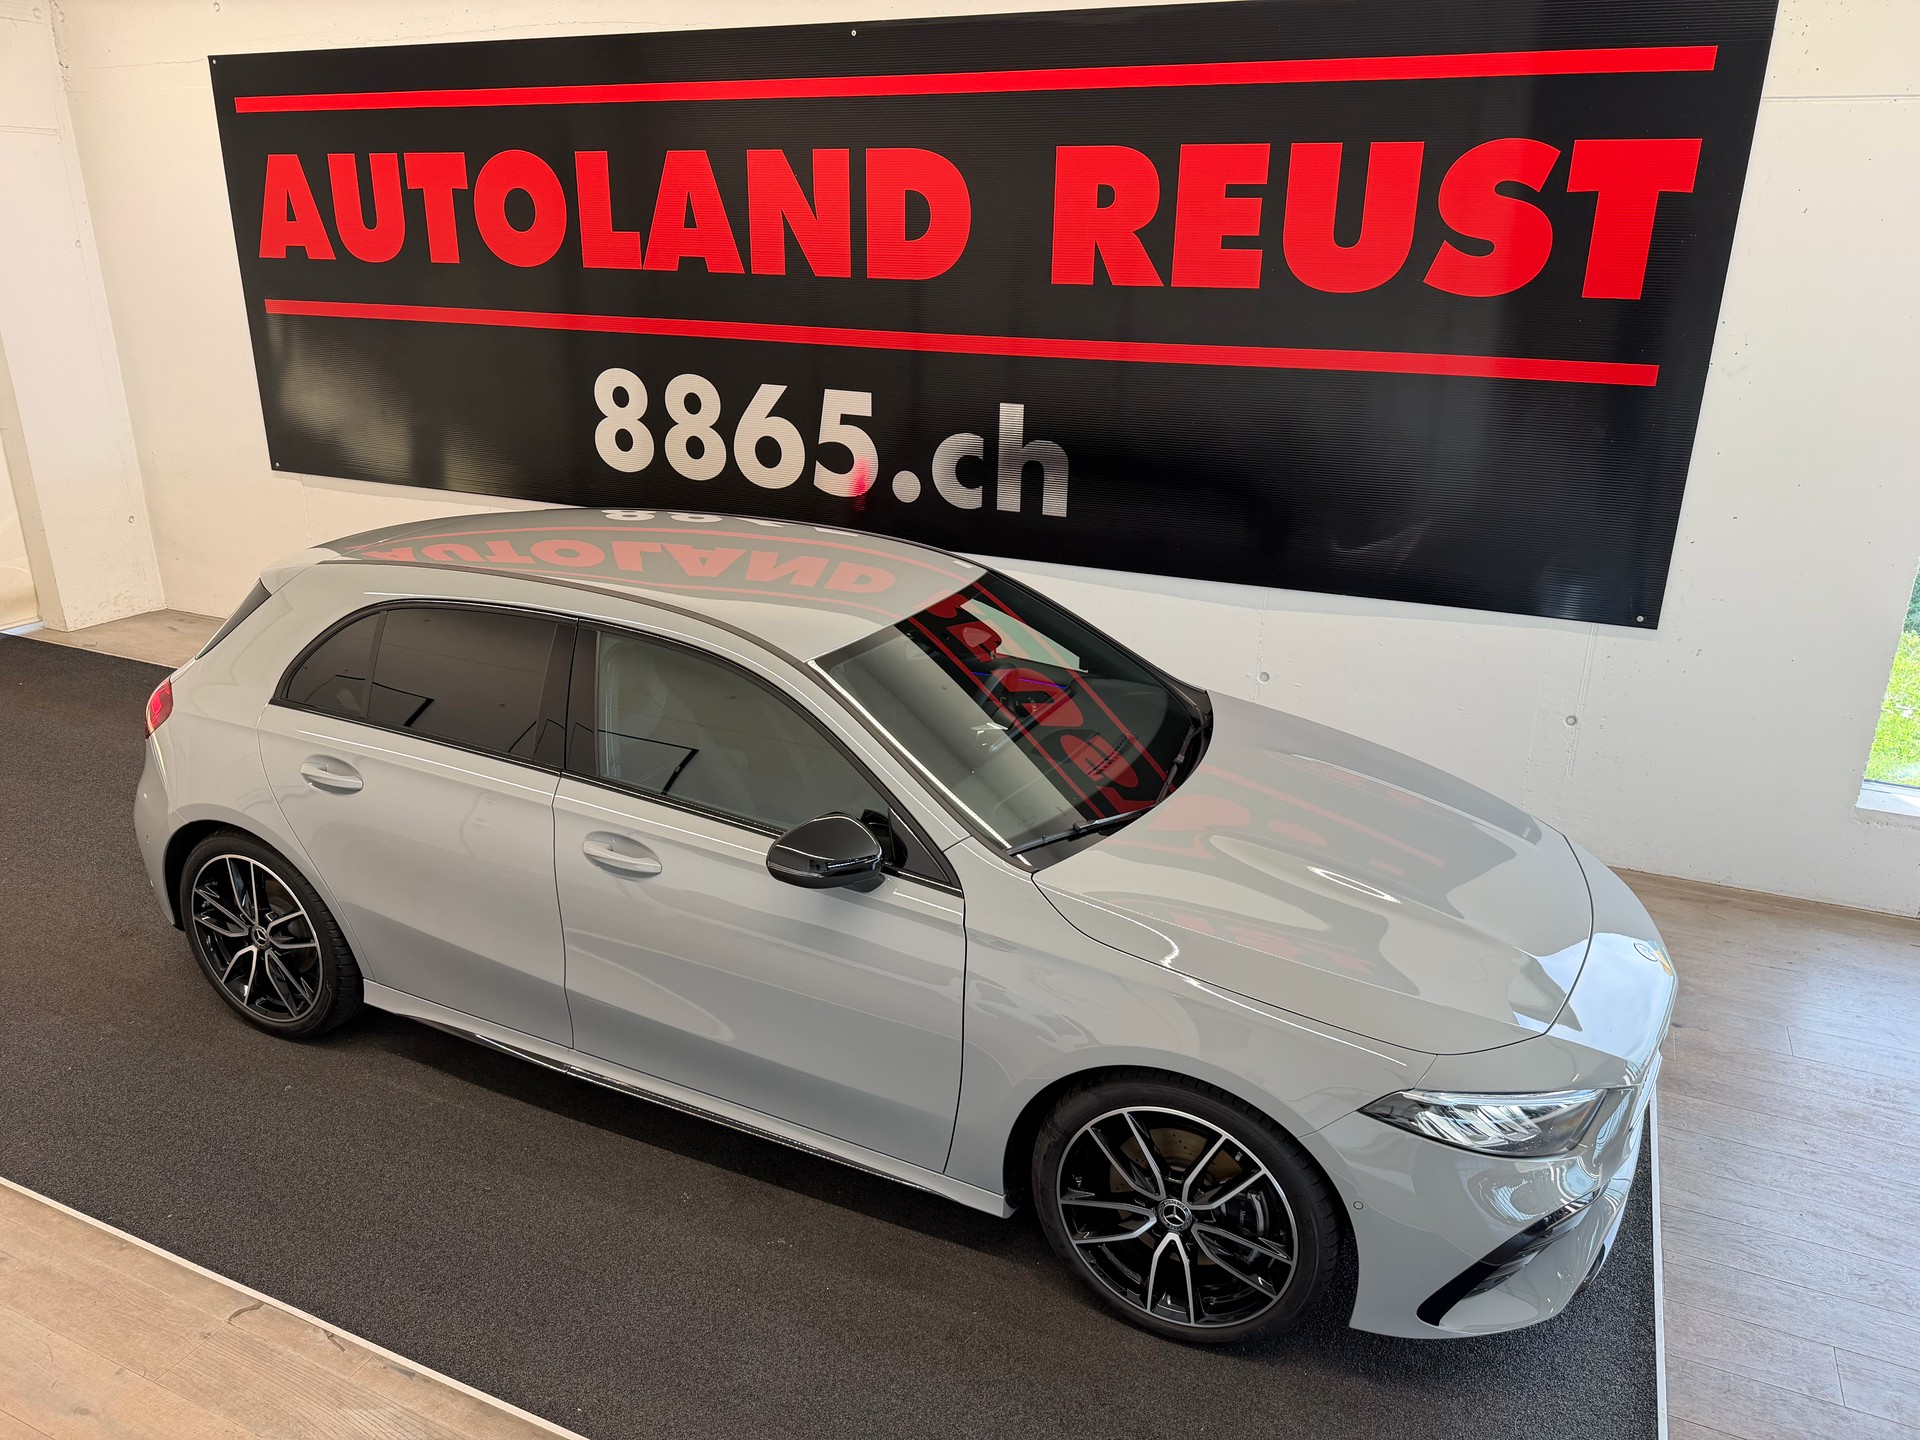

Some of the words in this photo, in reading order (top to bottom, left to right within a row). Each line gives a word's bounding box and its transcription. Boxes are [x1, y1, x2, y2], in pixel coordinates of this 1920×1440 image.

[259, 148, 971, 280] AUTOLAND
[1051, 138, 1702, 300] REUST
[593, 367, 1069, 518] 8865.ch
